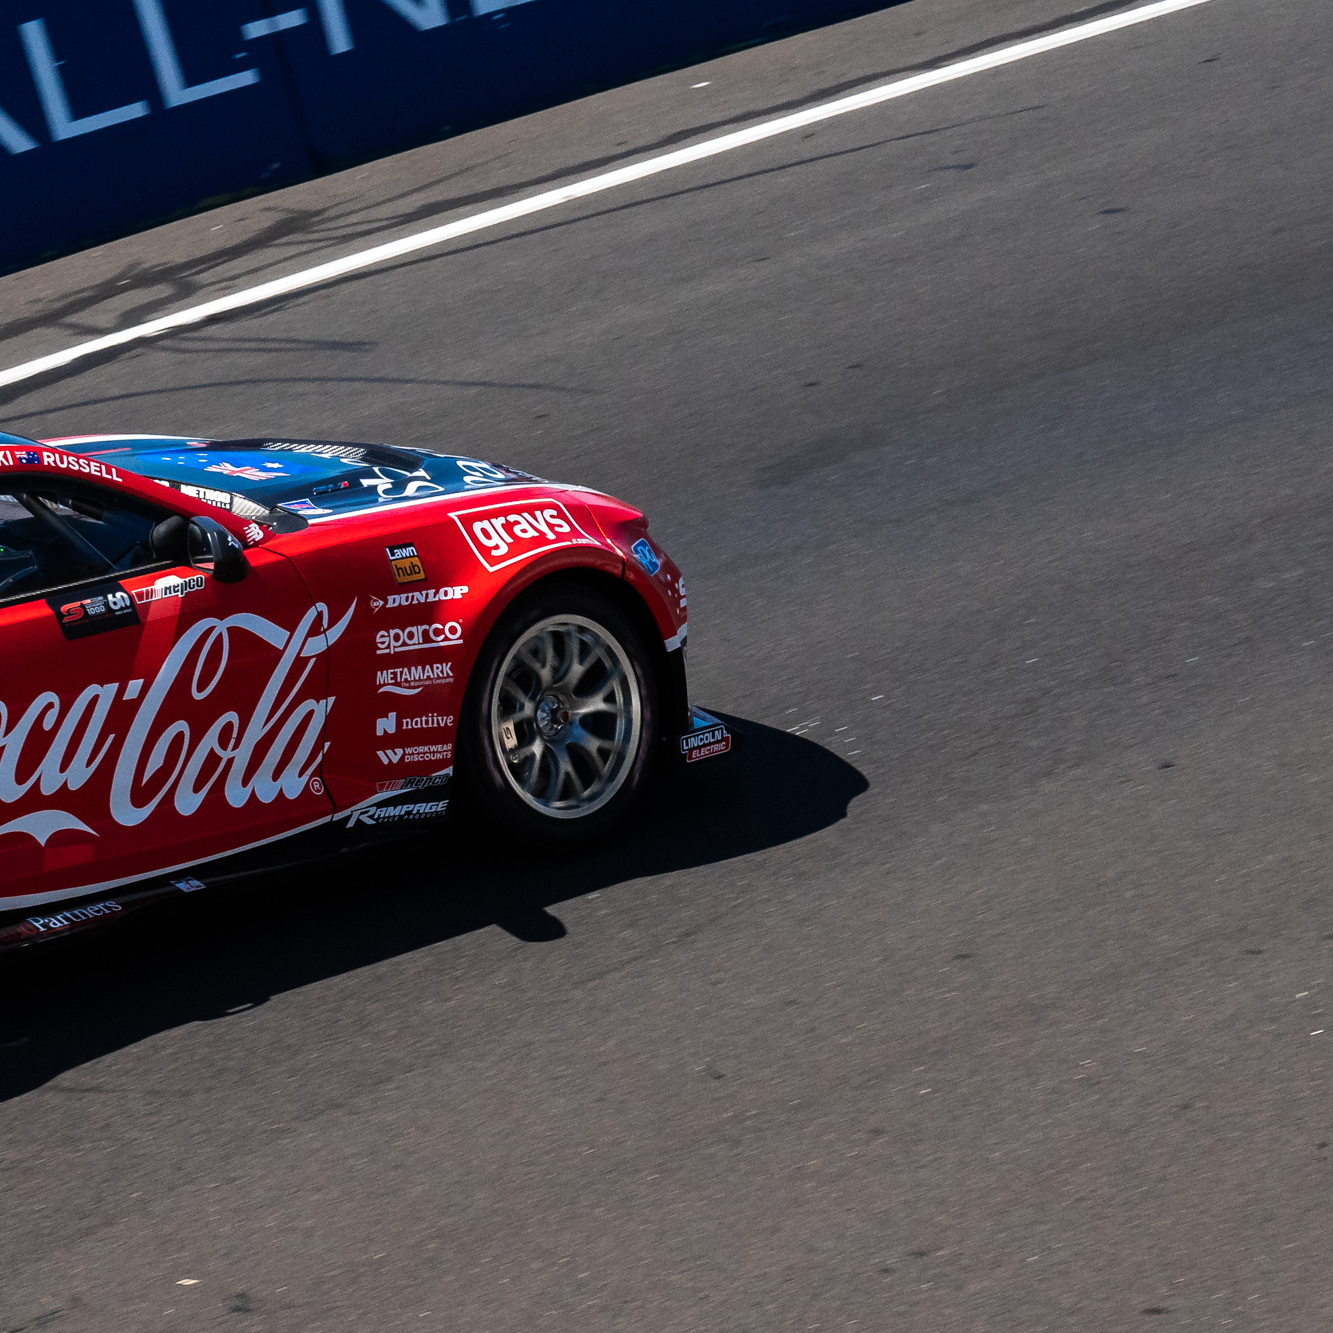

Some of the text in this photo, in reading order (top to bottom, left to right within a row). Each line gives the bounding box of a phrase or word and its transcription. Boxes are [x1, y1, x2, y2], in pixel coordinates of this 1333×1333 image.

[41, 451, 123, 482] RUSSELL
[472, 509, 571, 557] grays
[386, 546, 418, 561] Lawn
[395, 561, 421, 578] hub
[386, 585, 469, 608] DUNLOP
[375, 621, 462, 655] sparco
[376, 662, 454, 686] METAMARK
[402, 712, 454, 729] natiive
[405, 743, 453, 754] WORKWEAR
[682, 728, 723, 751] LINCOLN
[405, 751, 452, 763] DISCOUNTS
[691, 741, 727, 759] ELECTRIC
[346, 799, 450, 828] RAMPAGE
[403, 810, 446, 820] PRODUCTS
